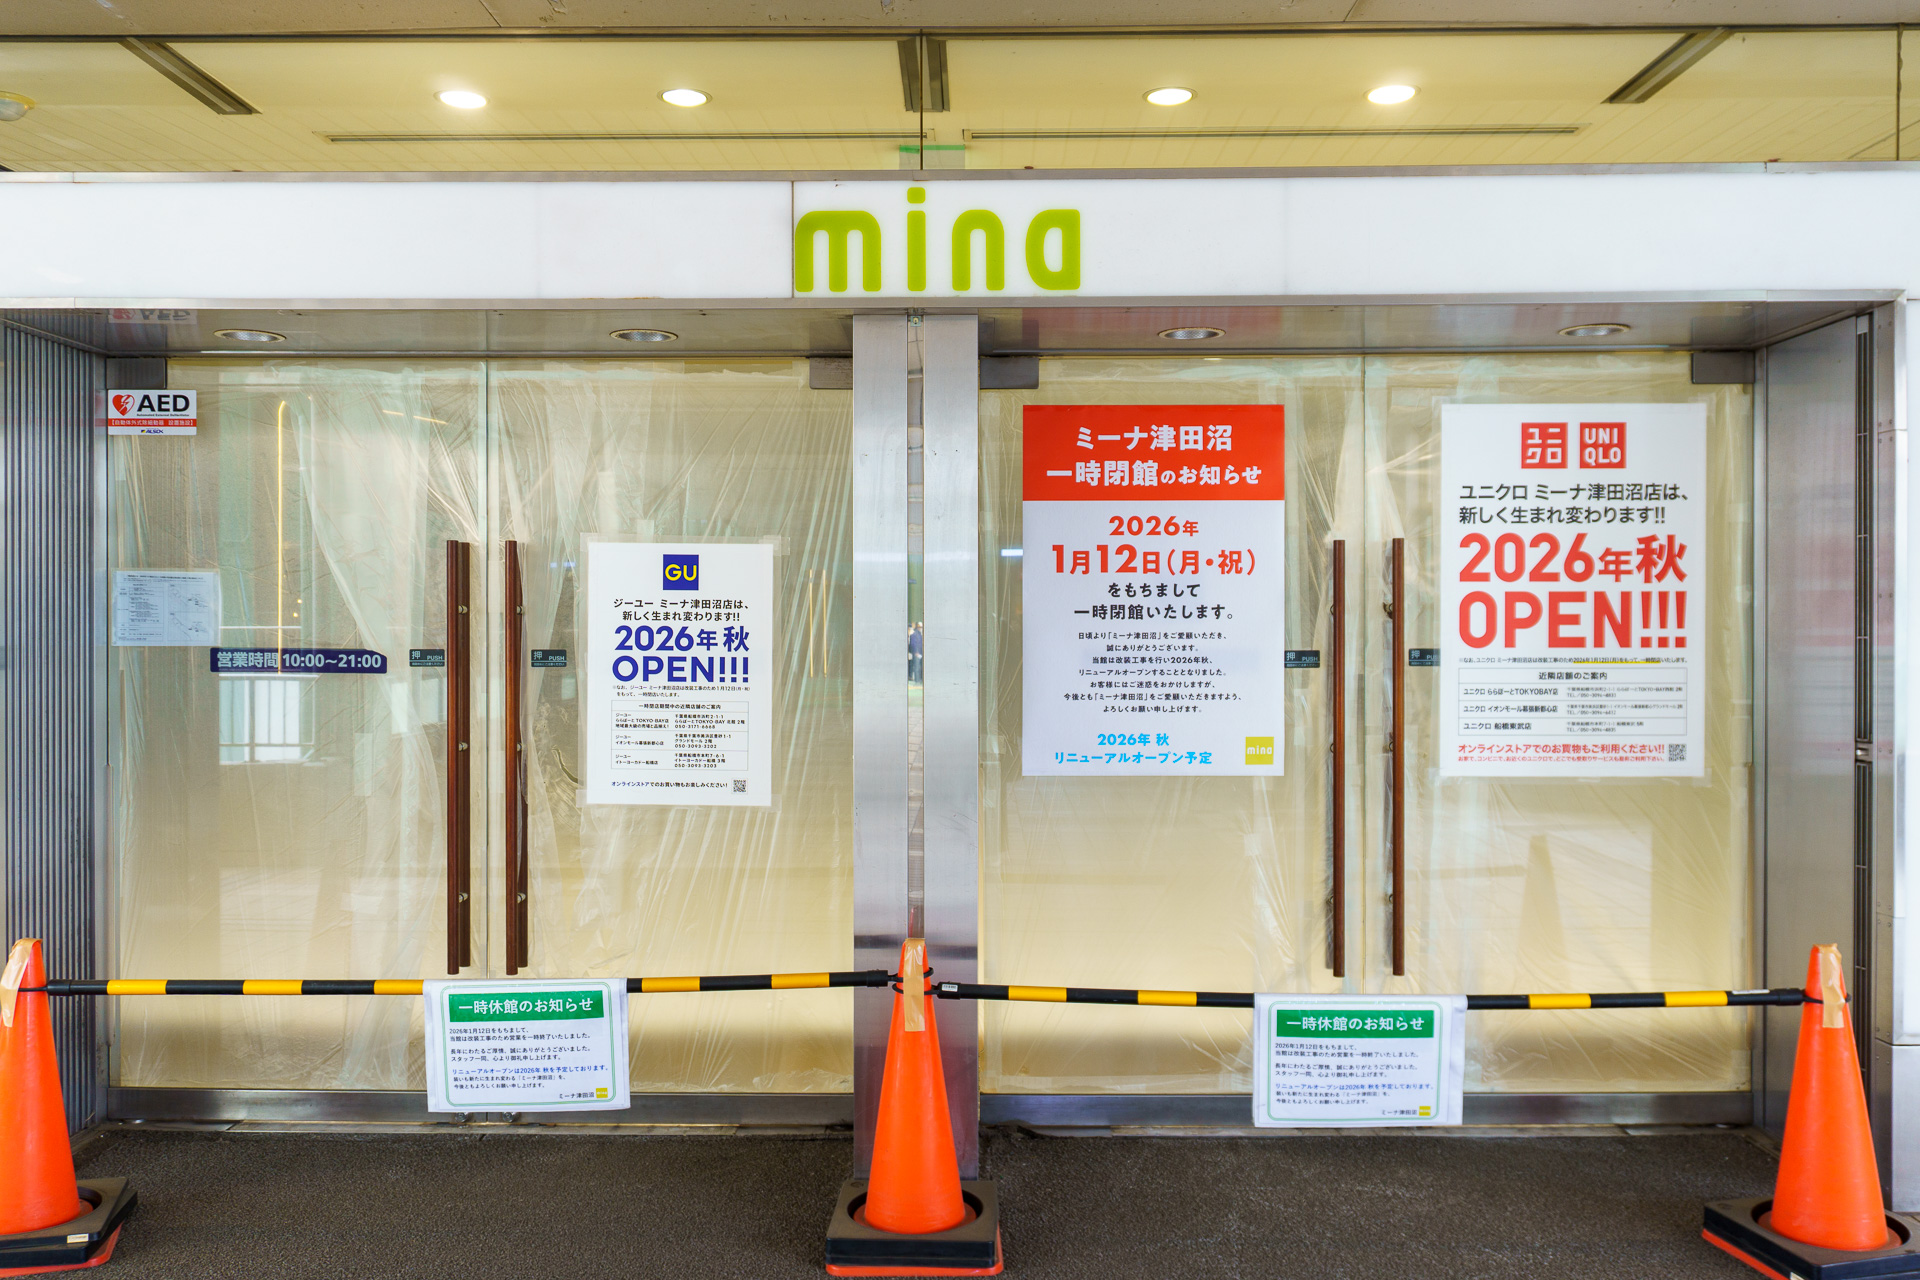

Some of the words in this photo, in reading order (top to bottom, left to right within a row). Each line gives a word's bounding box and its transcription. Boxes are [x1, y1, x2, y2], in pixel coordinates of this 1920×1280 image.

[795, 187, 1080, 292] mina
[137, 394, 190, 412] AED
[1076, 424, 1232, 450] ミーナ津田沼
[1584, 428, 1618, 444] UNI
[1584, 448, 1621, 466] QLO
[1046, 460, 1262, 486] 一時閉館のお知らせ
[1460, 484, 1528, 500] ユニクロ
[1535, 484, 1688, 501] ミーナ津田沼店は、
[1460, 507, 1665, 524] 新しく生まれ変わります!!
[1109, 516, 1199, 536] 2026年
[1460, 533, 1688, 584] 2026年秋
[665, 564, 697, 581] GU
[1108, 582, 1200, 597] をもちまして
[614, 599, 654, 608] ジーユー
[660, 599, 750, 609] ミーナ津田沼店は、
[622, 610, 740, 622] 新しく生まれ変わります!!
[1074, 604, 1234, 620] 一時閉館いたします。
[1459, 591, 1687, 648] OPEN!!!
[1078, 632, 1227, 640] 日頃より「ミーナ津田沼」をご愛顧いただき、
[1106, 644, 1199, 652] 誠にありがとうございます。
[217, 652, 278, 668] 営業時間
[412, 651, 420, 659] 押
[534, 651, 542, 660] 押
[1092, 656, 1213, 664] 当館は改装工事を行い2026年秋、
[1287, 652, 1295, 660] 押
[612, 655, 749, 683] OPEN!!!
[1078, 668, 1227, 676] リニューアルオープンすることとなりました。
[1538, 672, 1608, 680] 近隣店舗のご案内
[1090, 680, 1216, 688] お客様にはご迷惑をおかけしますが、
[1064, 693, 1242, 701] 今後とも「ミーナ津田沼」をご愛顧いただきますよう、
[1103, 705, 1202, 713] よろしくお願い申し上げます。
[1097, 734, 1150, 746] 2026年
[1156, 733, 1170, 746] 秋
[1247, 746, 1272, 755] mina
[1458, 744, 1664, 754] オンラインストアでのお買物もご利用ください!!
[1055, 752, 1212, 764] リニューアルオープン予定
[458, 998, 594, 1014] 一時休館のお知らせ
[1287, 1016, 1425, 1032] 一時休館のお知らせ
[450, 1033, 590, 1042] 当館は改装工事のため営業を一時終了いたしました。
[451, 1046, 590, 1054] 長年にわたるご厚情、誠にありがとうございました。
[451, 1054, 561, 1062] スタッフ一同、心より御礼申し上げます。
[452, 1066, 540, 1074] リニューアルオープンは2026年
[542, 1065, 608, 1074] 秋を予定しております。
